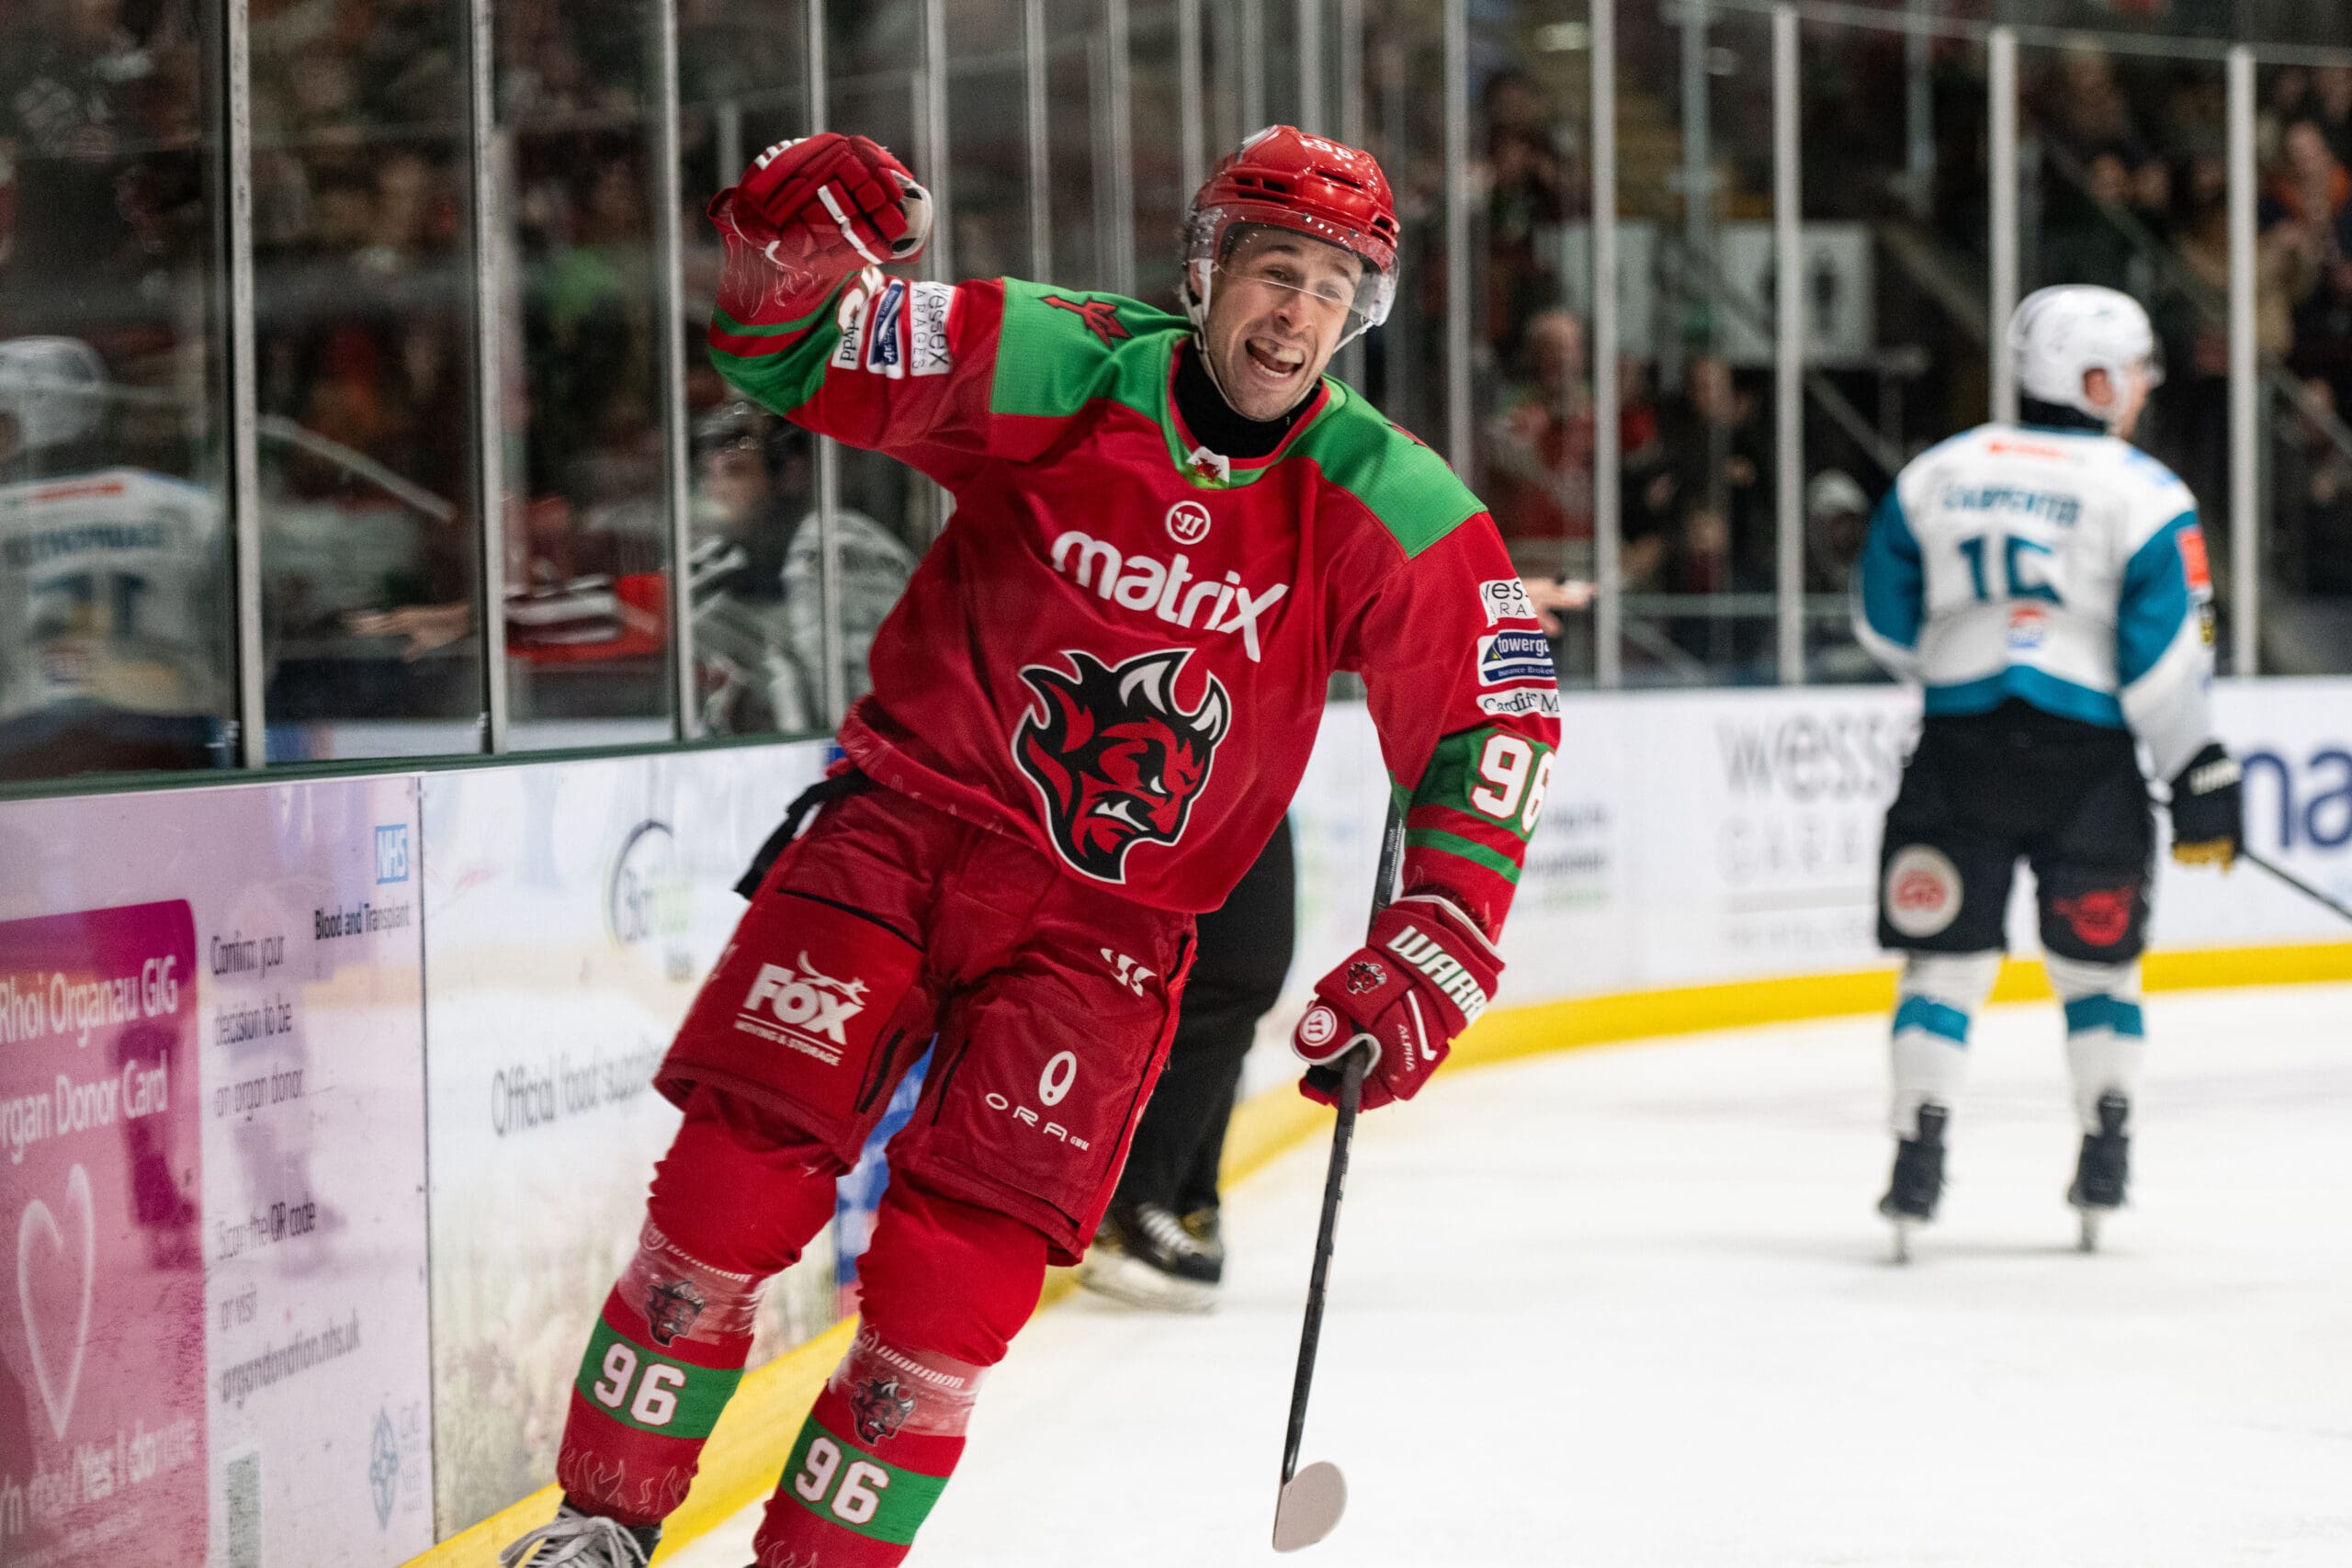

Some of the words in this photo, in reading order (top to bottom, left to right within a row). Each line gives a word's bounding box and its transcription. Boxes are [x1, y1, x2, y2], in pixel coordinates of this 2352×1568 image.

[911, 288, 927, 369] ARAGES
[1050, 530, 1289, 663] matrix
[1540, 694, 1560, 713] M
[1471, 734, 1556, 834] 96
[377, 828, 407, 880] NHS
[315, 905, 342, 940] Blood
[345, 902, 362, 935] and
[364, 898, 409, 935] Transplant
[210, 930, 257, 976] Confirm
[260, 935, 285, 979] your
[0, 974, 45, 1045] Rhoi
[49, 971, 140, 1048] Organau
[141, 953, 179, 1018] GIG
[277, 992, 292, 1034] be
[742, 962, 865, 1045] FOX
[1396, 1022, 1417, 1072] ALPHA
[0, 1092, 51, 1166] rgan
[55, 1073, 119, 1136] Donor
[122, 1049, 168, 1120] Card
[984, 1091, 1069, 1143] ORA
[270, 1201, 288, 1243] QR
[289, 1190, 316, 1237] code
[594, 1342, 687, 1427] 96
[795, 1437, 889, 1525] 96
